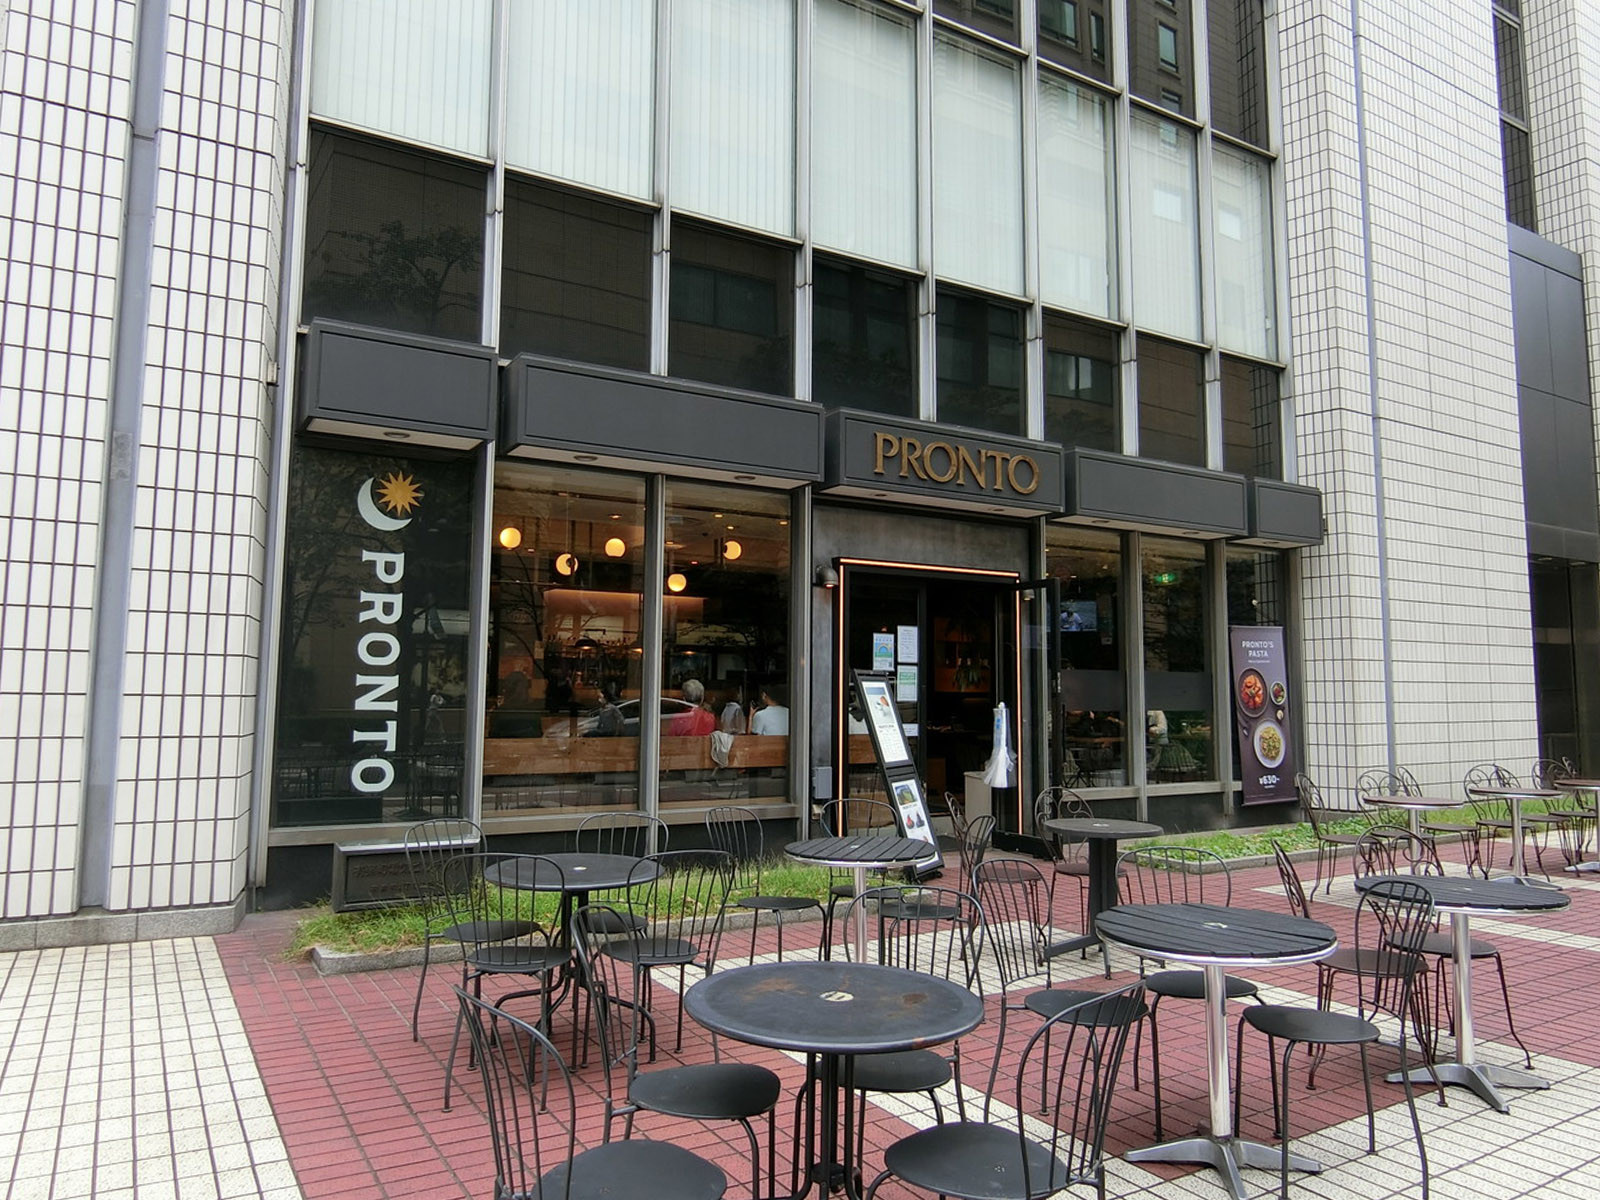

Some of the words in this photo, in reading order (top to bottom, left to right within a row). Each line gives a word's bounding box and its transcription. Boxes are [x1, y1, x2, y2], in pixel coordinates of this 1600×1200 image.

[874, 431, 1039, 494] PRONTO
[1241, 640, 1275, 649] PRONTO'S
[1248, 650, 1269, 658] PASTA
[351, 549, 405, 793] PRONTO
